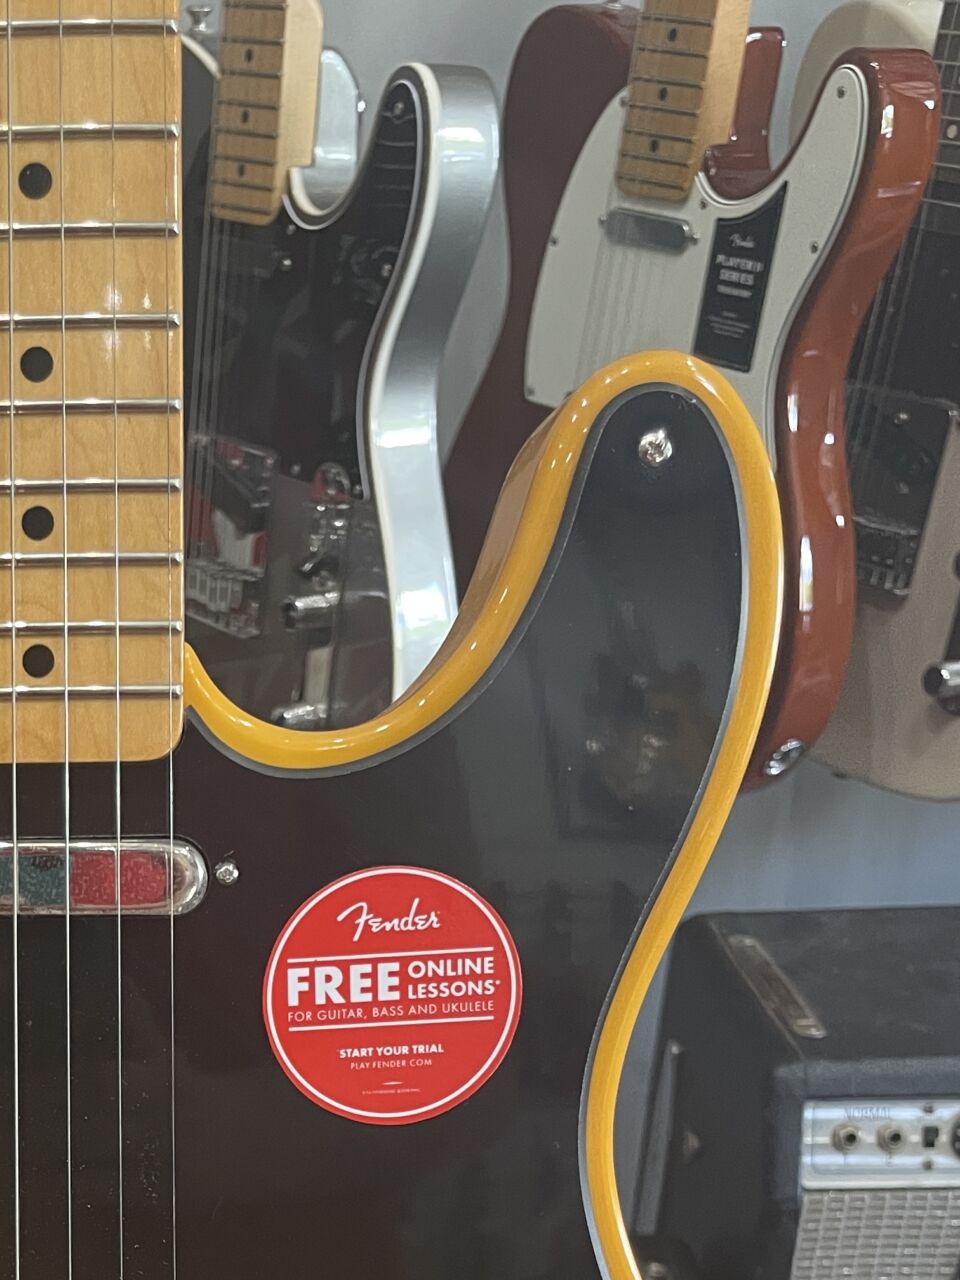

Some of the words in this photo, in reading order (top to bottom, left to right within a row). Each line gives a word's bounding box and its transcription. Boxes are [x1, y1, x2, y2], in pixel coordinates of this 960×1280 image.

[337, 897, 441, 942] Fender
[287, 962, 401, 1007] FREE
[407, 957, 495, 979] ONLINE
[287, 1011, 313, 1022] FOR
[317, 1008, 368, 1021] GUITAR,
[372, 1006, 404, 1018] BASS
[408, 1003, 437, 1016] AND
[441, 1000, 495, 1014] UKULELE
[339, 1047, 374, 1059] START
[376, 1045, 410, 1057] YOUR
[412, 1043, 445, 1055] TRIAL
